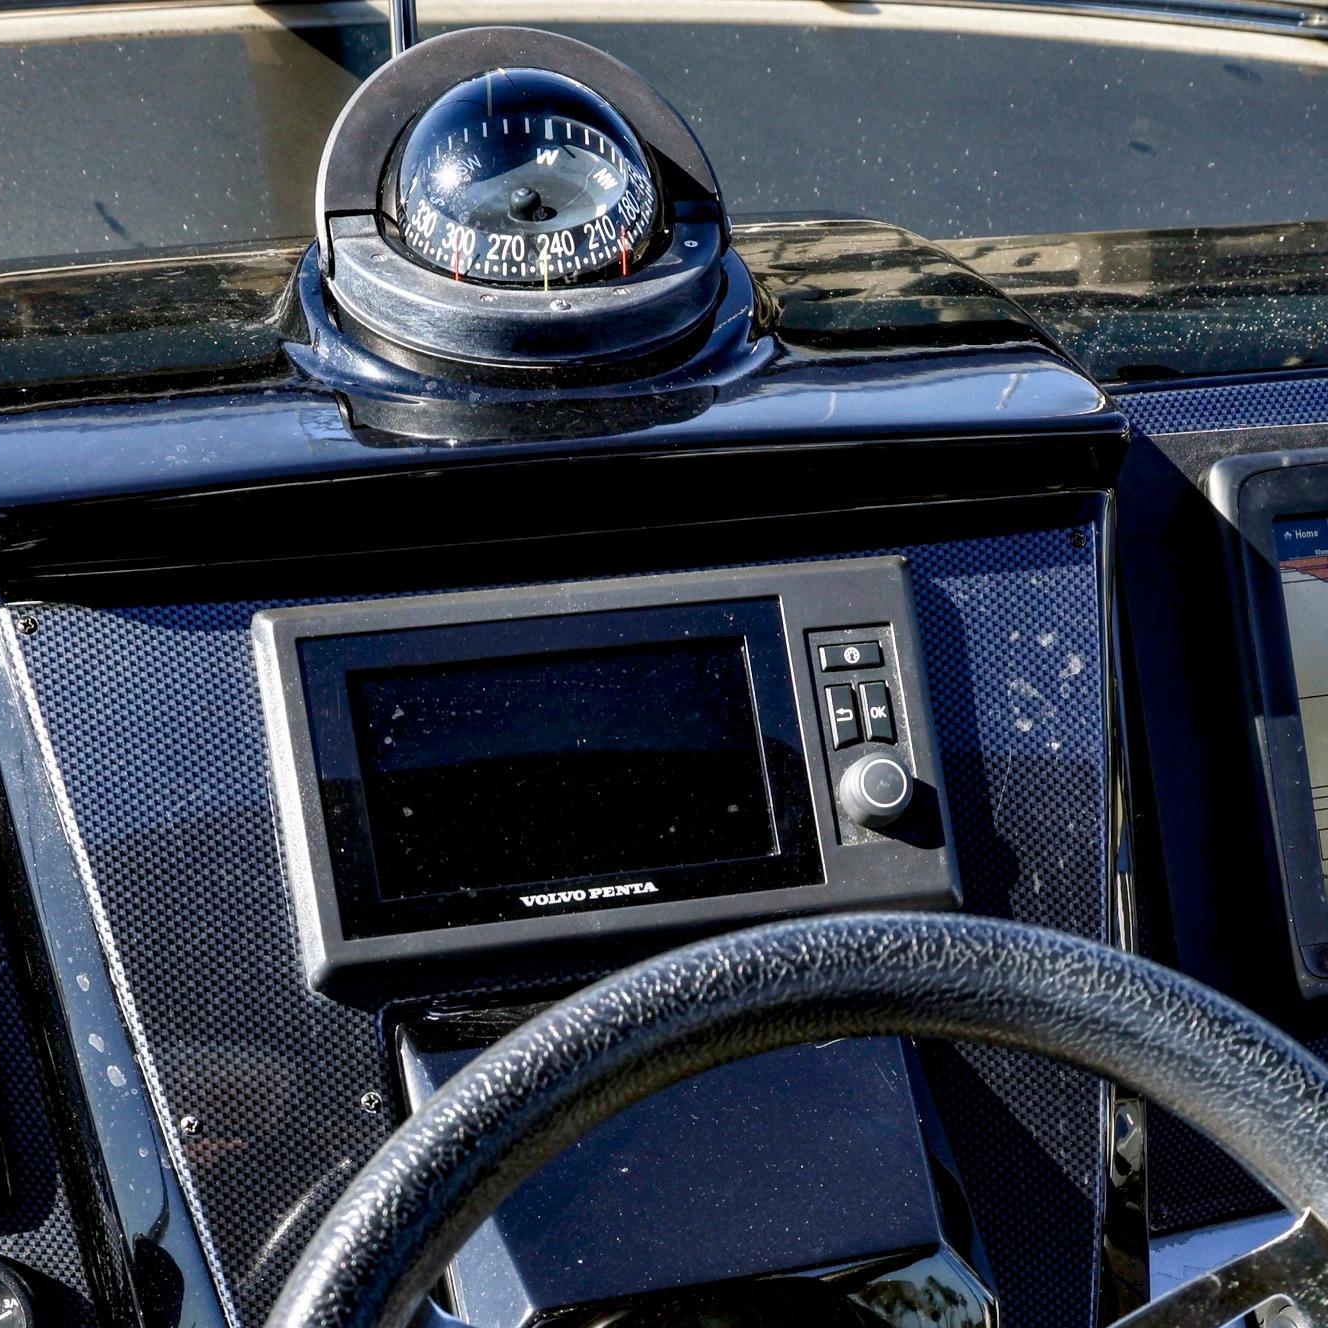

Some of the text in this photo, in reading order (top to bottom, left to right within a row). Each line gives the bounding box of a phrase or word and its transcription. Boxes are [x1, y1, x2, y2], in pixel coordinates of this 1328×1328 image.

[537, 148, 559, 165] W
[412, 189, 640, 262] 330 300 270 240 210 180
[1295, 529, 1320, 539] Home
[871, 705, 887, 719] OK
[520, 880, 659, 908] VOLVO PENTA
